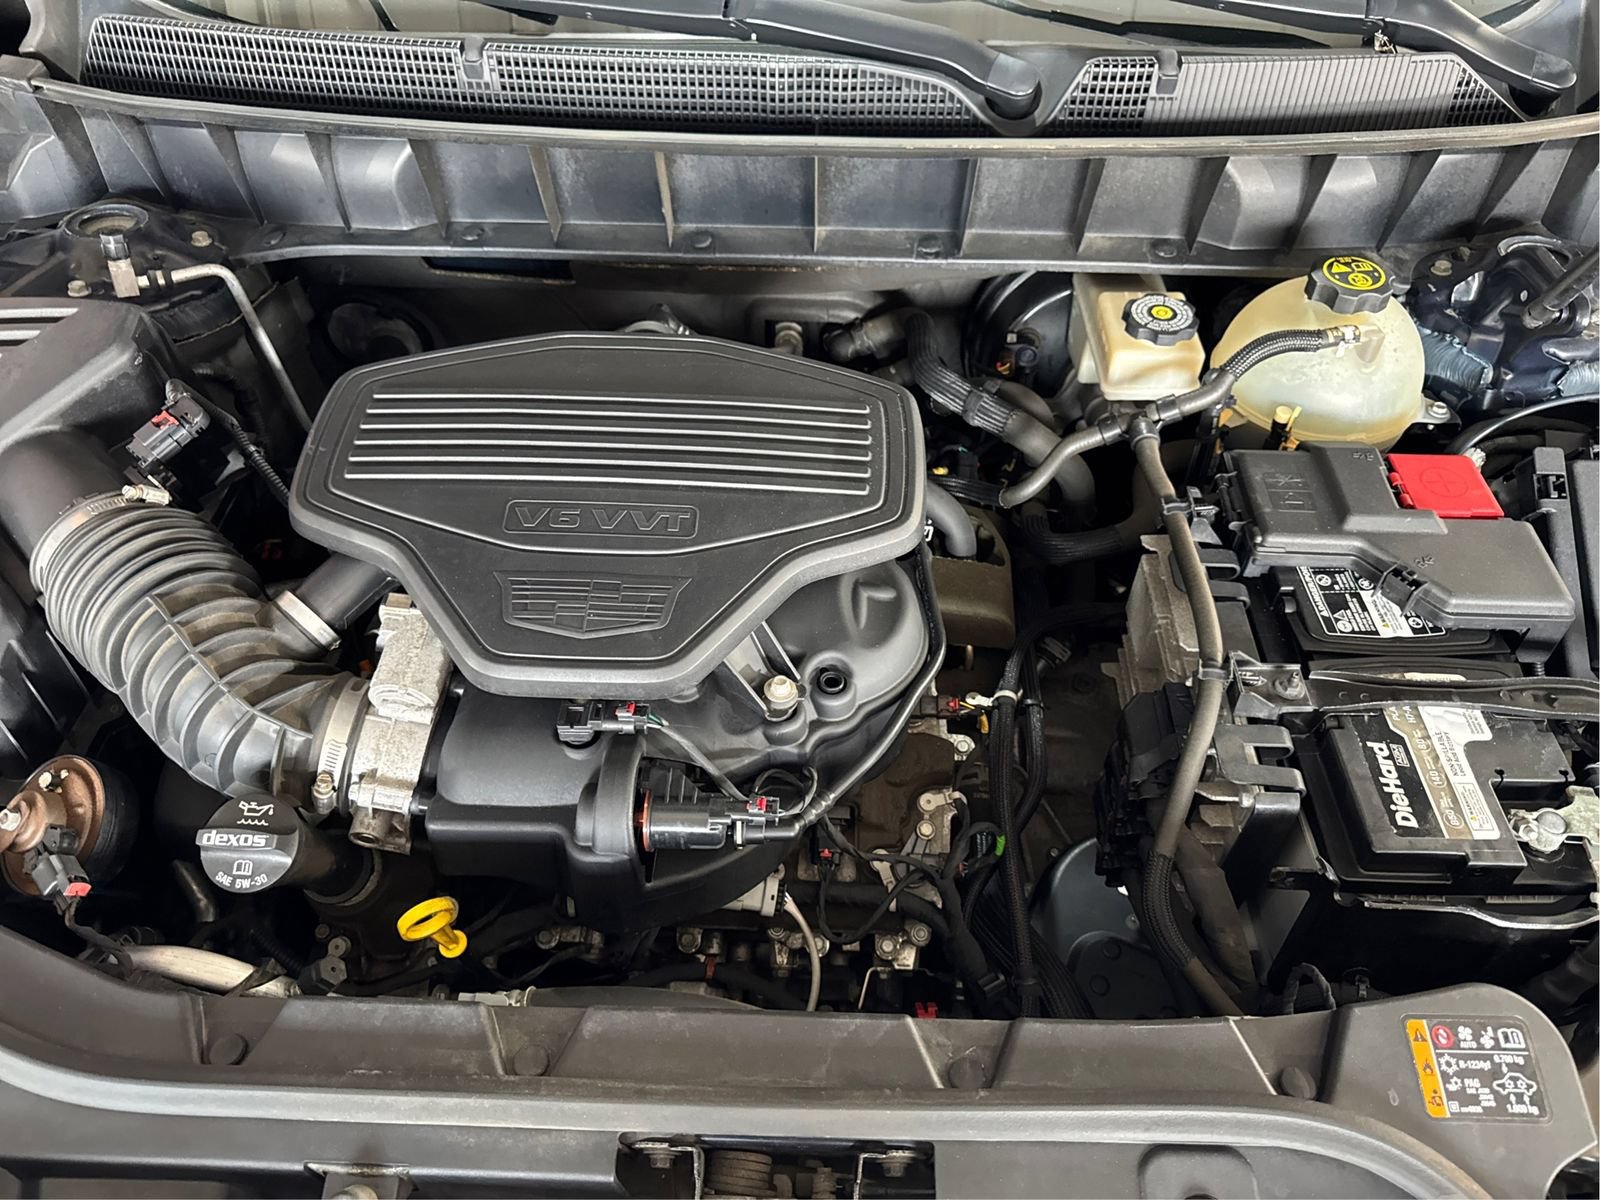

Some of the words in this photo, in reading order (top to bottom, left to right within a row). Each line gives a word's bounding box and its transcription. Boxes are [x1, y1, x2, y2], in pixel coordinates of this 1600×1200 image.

[515, 507, 580, 527] V6
[592, 509, 690, 532] VVT
[1366, 741, 1419, 828] DieHard
[1429, 770, 1443, 785] 140
[1446, 809, 1460, 826] 850
[202, 829, 267, 847] dexos
[215, 871, 233, 887] SAE
[235, 874, 268, 889] 5W-30
[1460, 1041, 1477, 1049] AUTO
[1463, 1078, 1481, 1088] PAG
